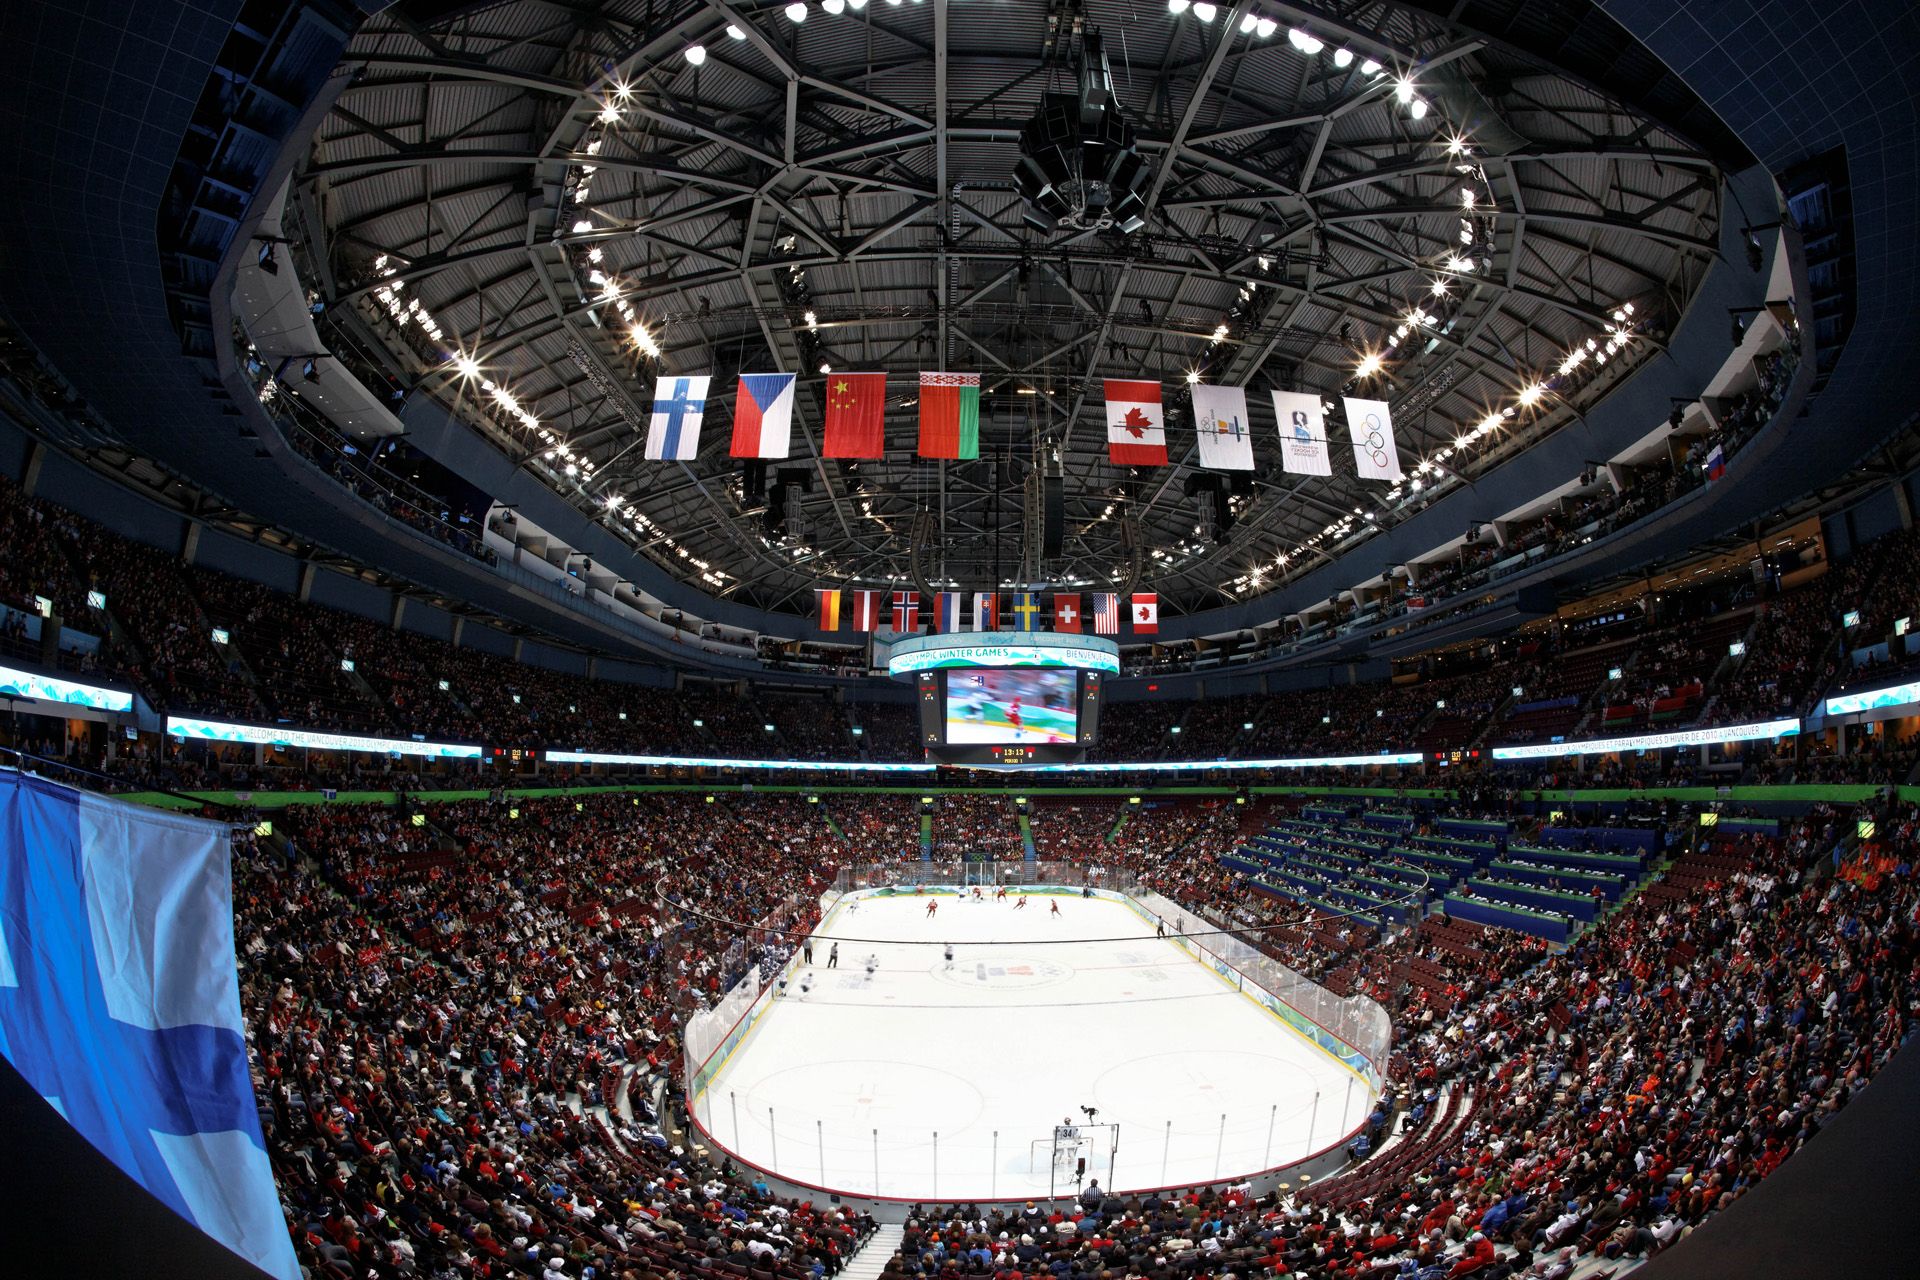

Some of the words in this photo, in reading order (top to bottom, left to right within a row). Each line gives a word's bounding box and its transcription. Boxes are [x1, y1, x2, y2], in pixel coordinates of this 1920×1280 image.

[909, 651, 937, 662] OLYMPIC
[940, 649, 972, 659] WINTER
[976, 648, 1009, 657] GAMES
[1066, 650, 1102, 661] BIENVENUE
[244, 728, 277, 740] WELCOME
[280, 731, 289, 741] TO
[291, 732, 304, 742] THE
[306, 734, 347, 746] VANCOUVER
[349, 738, 364, 747] 2010
[366, 740, 391, 749] OLYMPIC
[392, 742, 413, 750] WINTER
[1572, 742, 1605, 752] OLYMPIQUES
[1606, 740, 1613, 749] ET
[1614, 736, 1662, 748] PARALYMPIQUES
[1691, 732, 1699, 741] DE
[1702, 730, 1718, 740] 2010
[1723, 726, 1760, 738] VANCOUVER
[1063, 1129, 1072, 1137] 34
